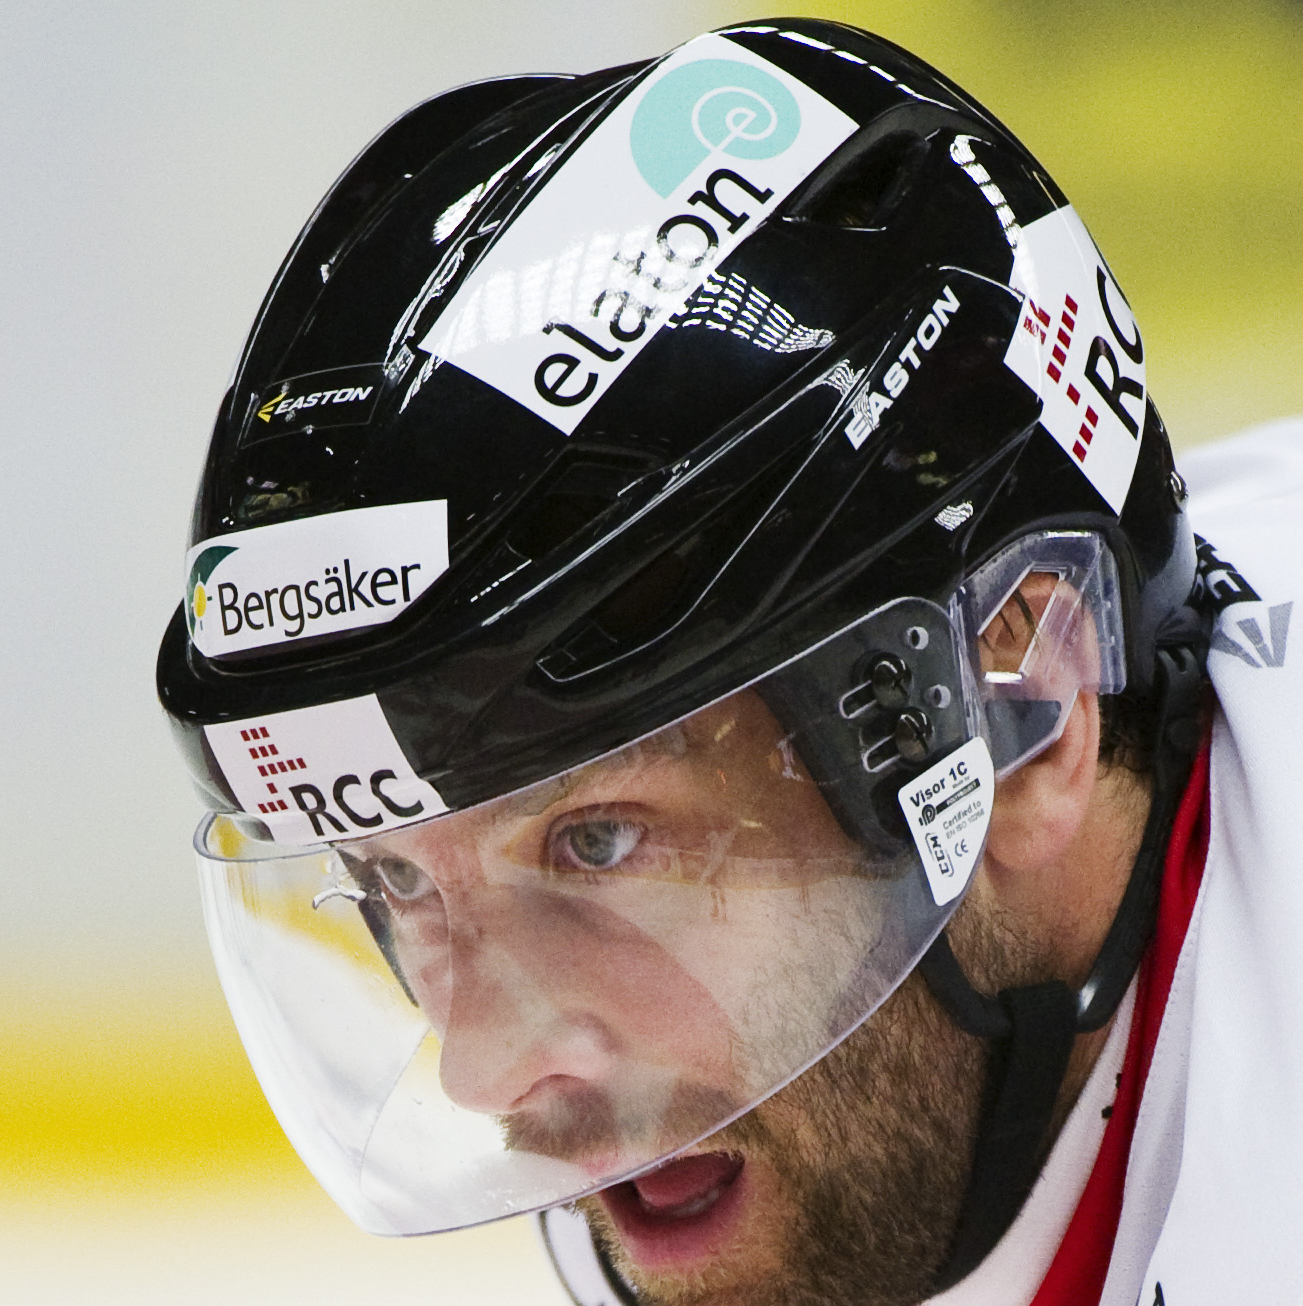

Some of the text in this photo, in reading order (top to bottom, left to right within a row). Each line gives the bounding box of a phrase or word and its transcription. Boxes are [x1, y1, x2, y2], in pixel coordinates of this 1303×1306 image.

[844, 285, 961, 450] EASTON
[1084, 264, 1144, 441] RC
[274, 386, 373, 415] EASTON
[217, 558, 421, 638] Bergsäker
[288, 769, 425, 836] RCC
[910, 778, 946, 808] Visor
[948, 761, 968, 782] 1C
[942, 804, 973, 831] Certified
